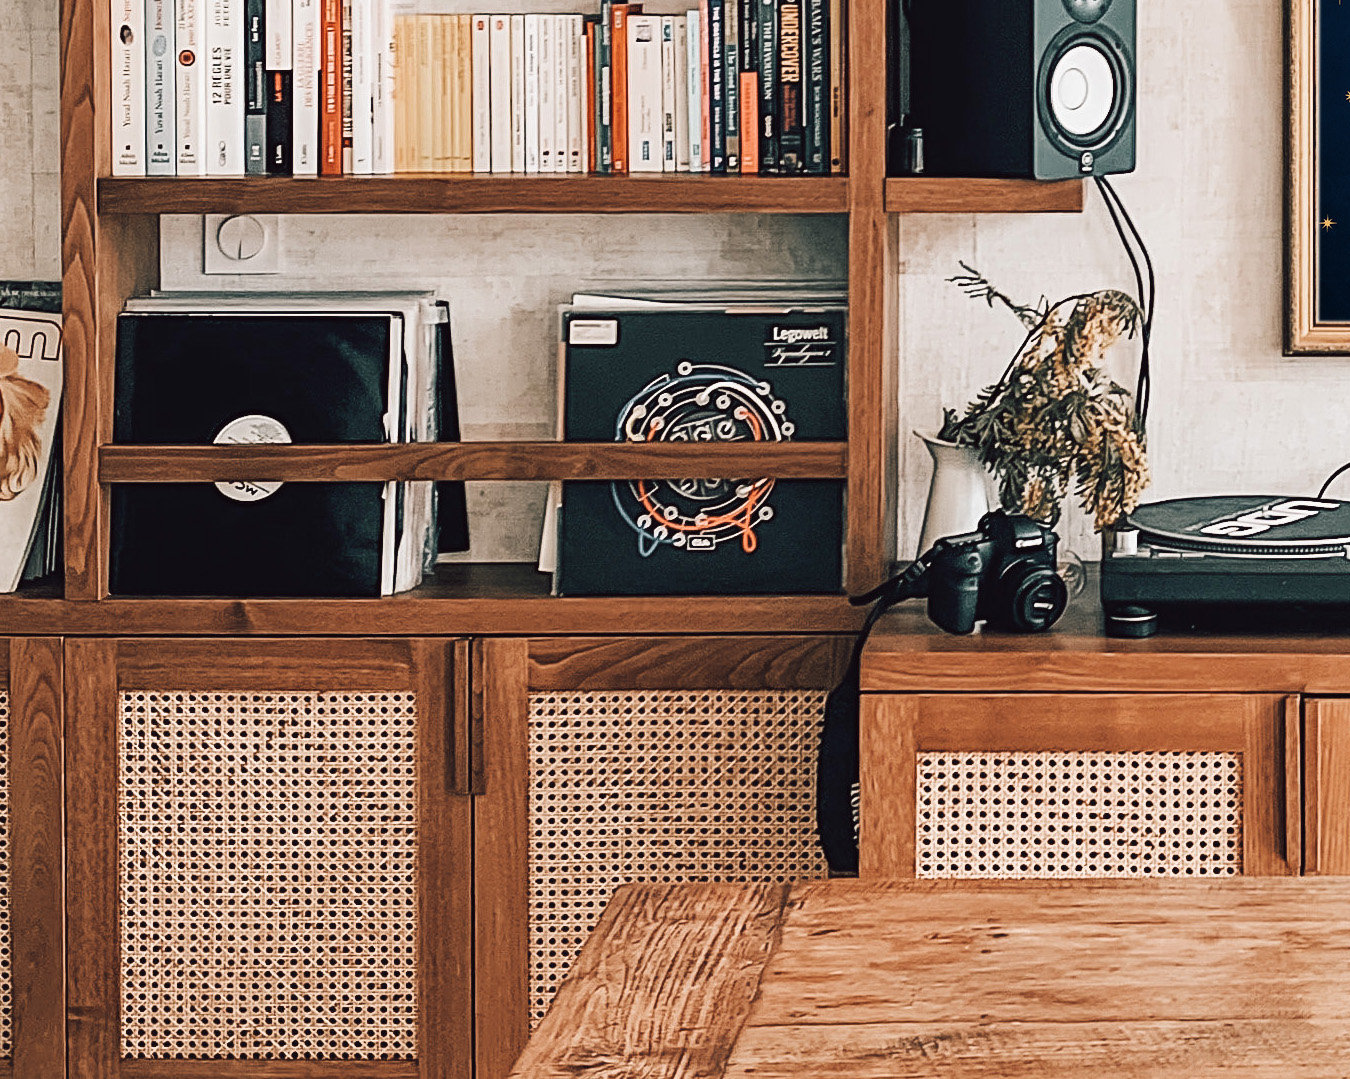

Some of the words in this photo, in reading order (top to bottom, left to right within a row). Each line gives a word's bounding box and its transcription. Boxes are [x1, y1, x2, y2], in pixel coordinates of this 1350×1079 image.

[763, 21, 772, 40] THE
[780, 4, 799, 83] UNDERCOVER
[122, 49, 132, 76] Harari
[154, 59, 163, 86] Harari
[212, 46, 222, 88] RÈGLES
[763, 41, 772, 100] REVOLUTION
[811, 48, 823, 81] WARS
[122, 79, 132, 102] Noah
[154, 88, 163, 110] Noah
[212, 92, 222, 105] 12
[122, 103, 132, 127] Yuval
[154, 111, 163, 134] Yuval
[772, 326, 829, 343] Legowelt
